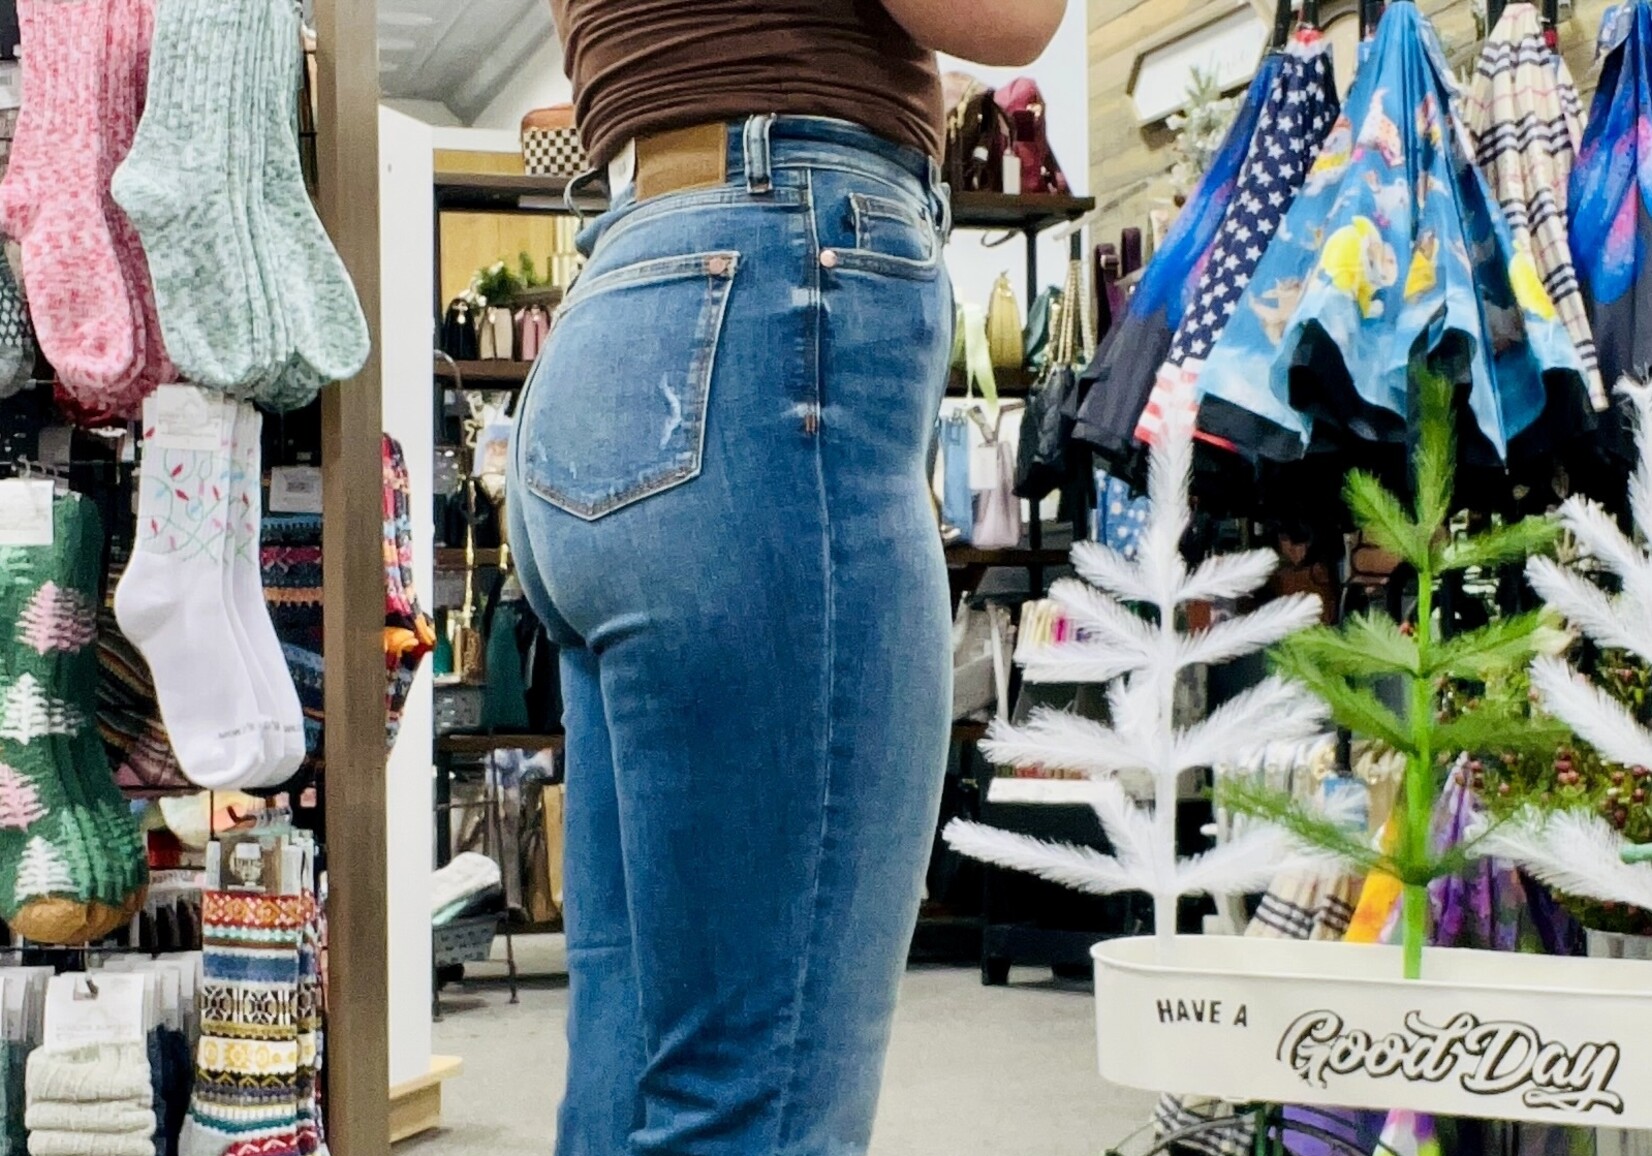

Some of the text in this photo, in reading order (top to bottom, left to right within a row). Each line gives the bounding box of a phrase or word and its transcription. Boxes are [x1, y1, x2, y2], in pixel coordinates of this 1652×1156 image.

[1157, 999, 1624, 1115] HAVE A Good Day
